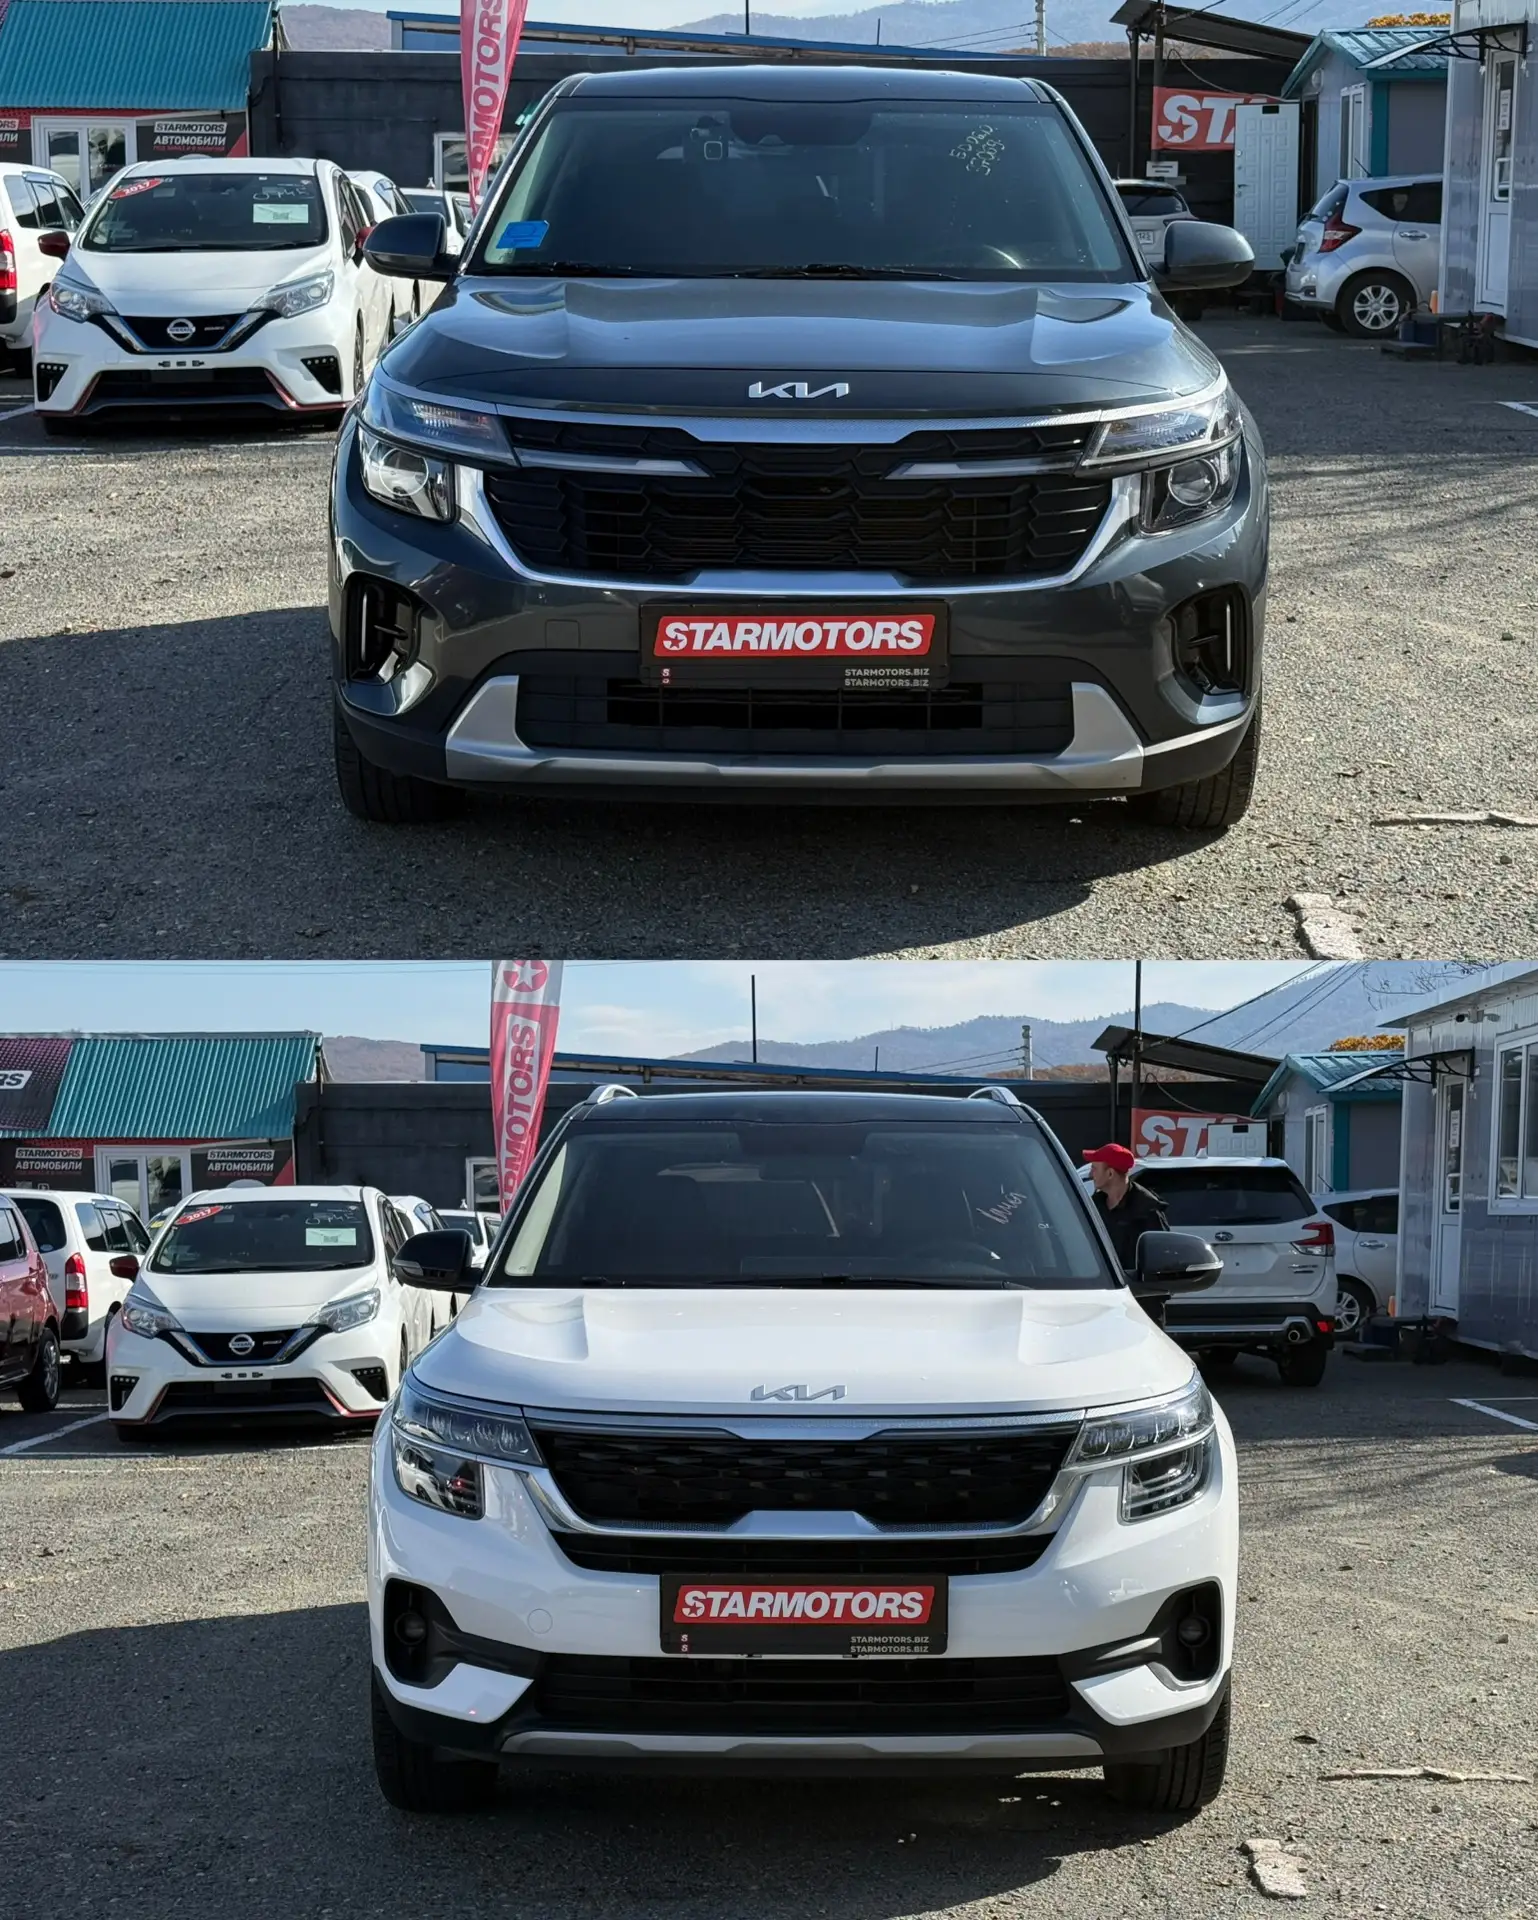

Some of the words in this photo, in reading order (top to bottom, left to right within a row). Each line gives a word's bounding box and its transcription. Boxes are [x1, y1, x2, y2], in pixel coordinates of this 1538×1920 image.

[1157, 94, 1267, 144] ST
[156, 123, 225, 133] STARMOTORS
[153, 135, 227, 146] АВТОМОБИЛИ
[123, 181, 150, 195] 2017
[748, 381, 849, 399] KIA
[662, 620, 924, 651] STARMOTORS
[844, 667, 930, 677] STARMOTORS.BIZ
[1136, 1115, 1238, 1157] ST
[17, 1148, 81, 1158] STARMOTORS
[209, 1150, 273, 1159] STARMOTORS
[15, 1160, 83, 1170] АВТОМОБИЛИ
[207, 1162, 274, 1172] АВТОМОБИЛИ
[186, 1207, 212, 1221] 2017
[750, 1384, 847, 1401] KIA
[681, 1590, 925, 1620] STARMOTORS
[850, 1636, 930, 1644] STARMOTORS.BIZ
[850, 1645, 929, 1653] STARMOTORS.BIZ
